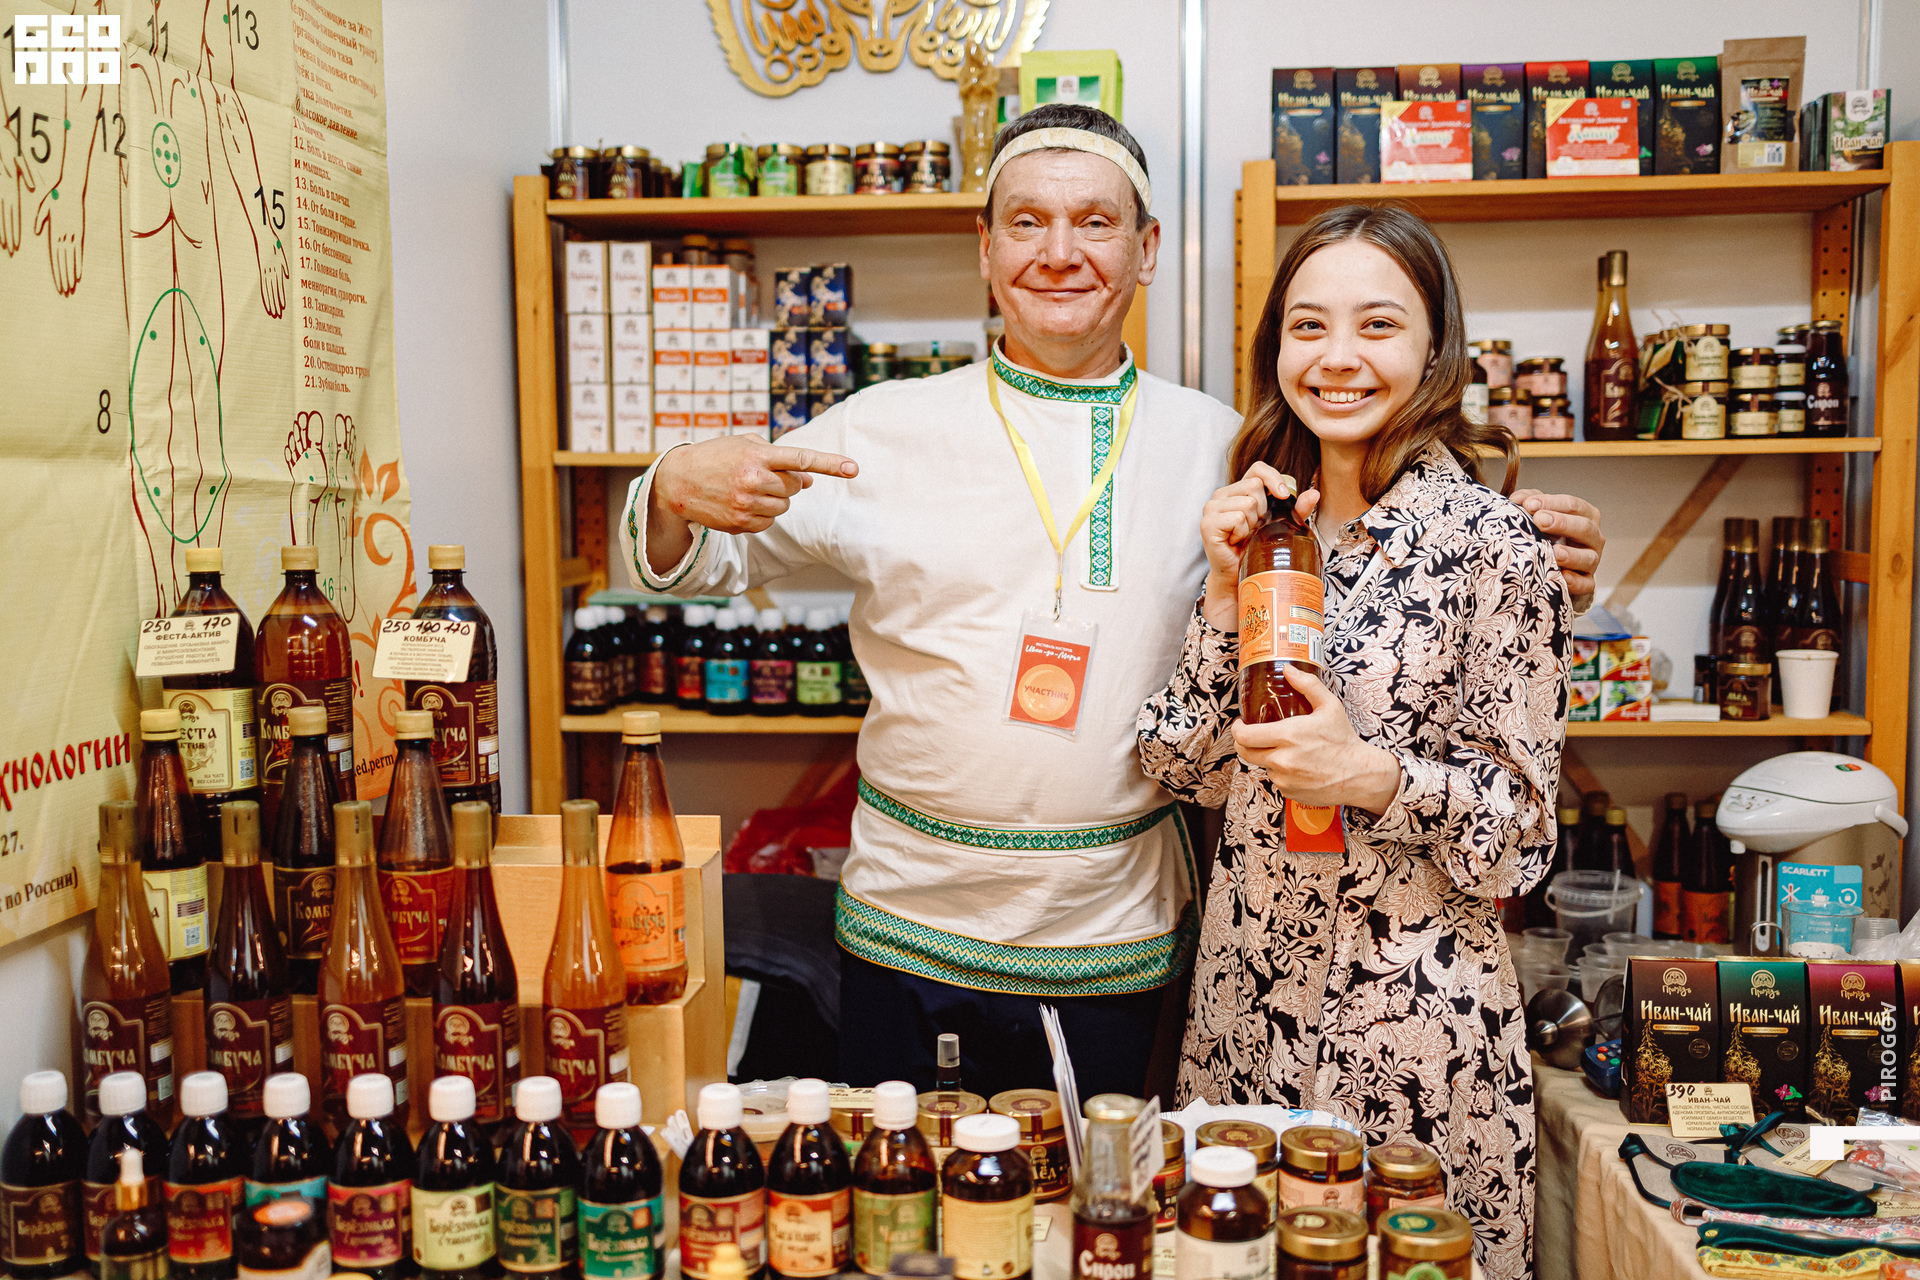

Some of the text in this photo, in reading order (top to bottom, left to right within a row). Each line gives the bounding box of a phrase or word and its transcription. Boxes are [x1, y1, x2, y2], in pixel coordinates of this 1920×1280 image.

[231, 4, 259, 50] 13
[147, 15, 169, 62] 11
[336, 51, 354, 66] таза
[7, 106, 51, 164] 15
[96, 107, 127, 160] 12
[326, 118, 358, 140] давление.
[294, 135, 306, 150] 12.
[294, 158, 331, 181] и мышцах.
[295, 175, 309, 191] 13.
[309, 179, 326, 198] Боль
[254, 185, 286, 230] 15
[296, 195, 310, 211] 14.
[310, 199, 320, 214] От
[319, 203, 335, 220] боли
[297, 215, 311, 231] 15.
[298, 236, 312, 251] 16.
[312, 239, 321, 252] От
[299, 256, 313, 271] 17.
[313, 258, 339, 279] Головная
[302, 296, 314, 310] 18.
[303, 315, 315, 330] 19.
[303, 335, 321, 350] боли
[303, 354, 317, 370] 20.
[304, 374, 318, 389] 21.
[97, 388, 111, 434] 8
[322, 493, 334, 512] 17
[322, 577, 335, 602] 16
[143, 616, 231, 633] 250 170
[383, 619, 411, 633] 250
[155, 630, 222, 641] ФЕСТА-АКТИВ
[403, 635, 446, 644] КОМБУЧА
[1024, 685, 1070, 701] УЧАСТНИК
[260, 718, 290, 740] Комб
[1781, 865, 1830, 877] SCARLETT
[6, 866, 78, 911] по России)
[295, 901, 331, 919] Комб
[1641, 1000, 1712, 1022] Иван-чай
[1729, 1002, 1800, 1024] Иван-чай
[1667, 1084, 1695, 1099] 390
